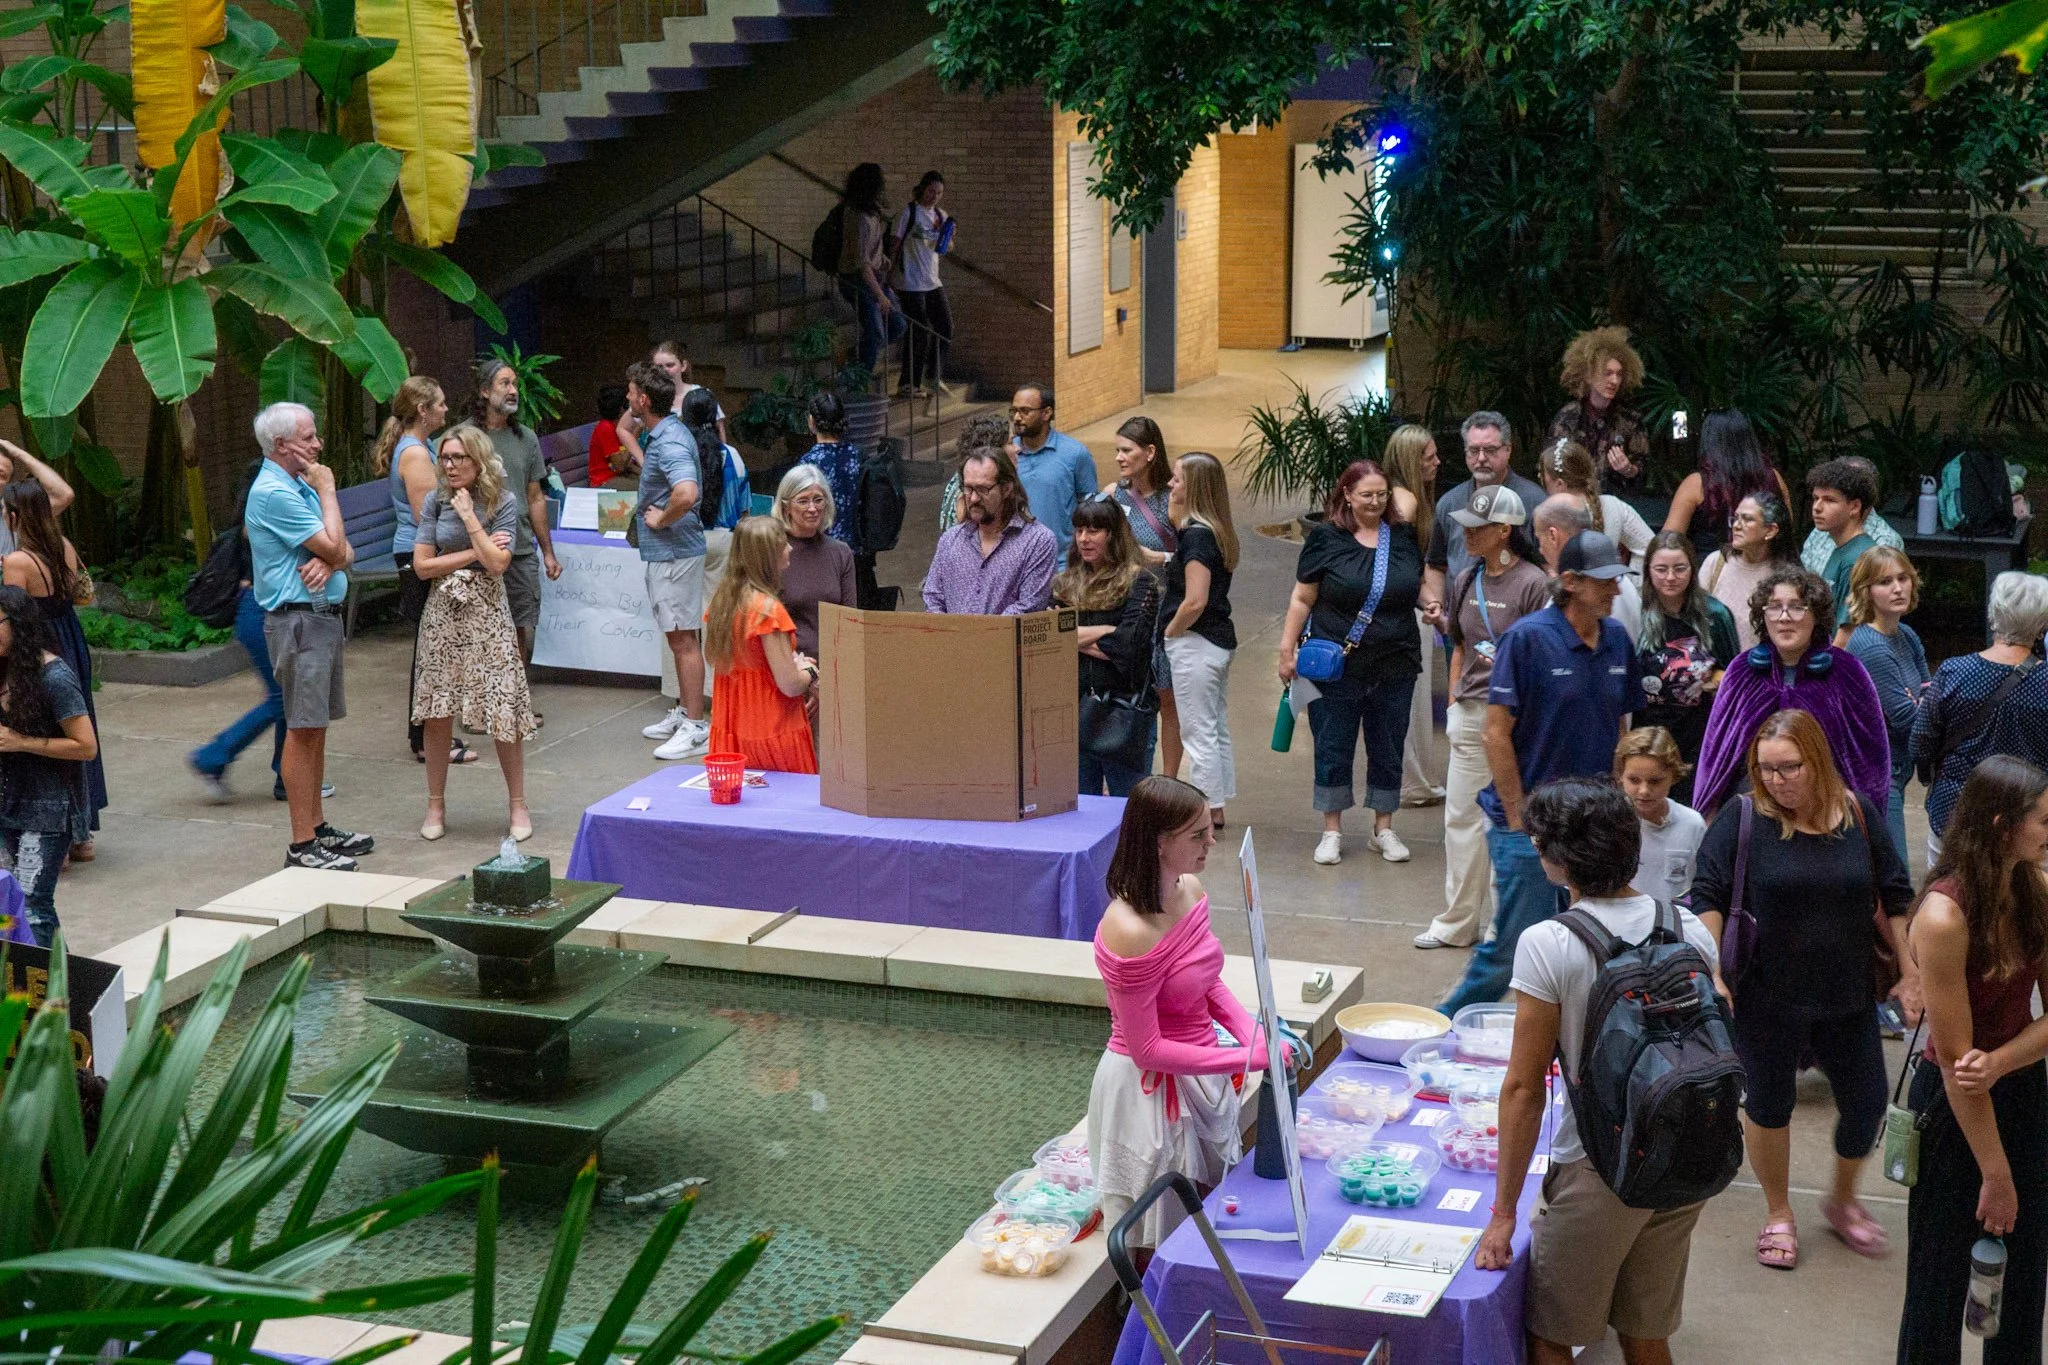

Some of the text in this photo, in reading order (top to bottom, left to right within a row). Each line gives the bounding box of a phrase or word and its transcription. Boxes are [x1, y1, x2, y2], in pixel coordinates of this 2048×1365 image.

[563, 556, 623, 578] Judging
[554, 585, 642, 618] Books By
[546, 614, 655, 642] Their Covers
[1023, 621, 1052, 634] PROJECT
[1023, 633, 1047, 645] BOARD
